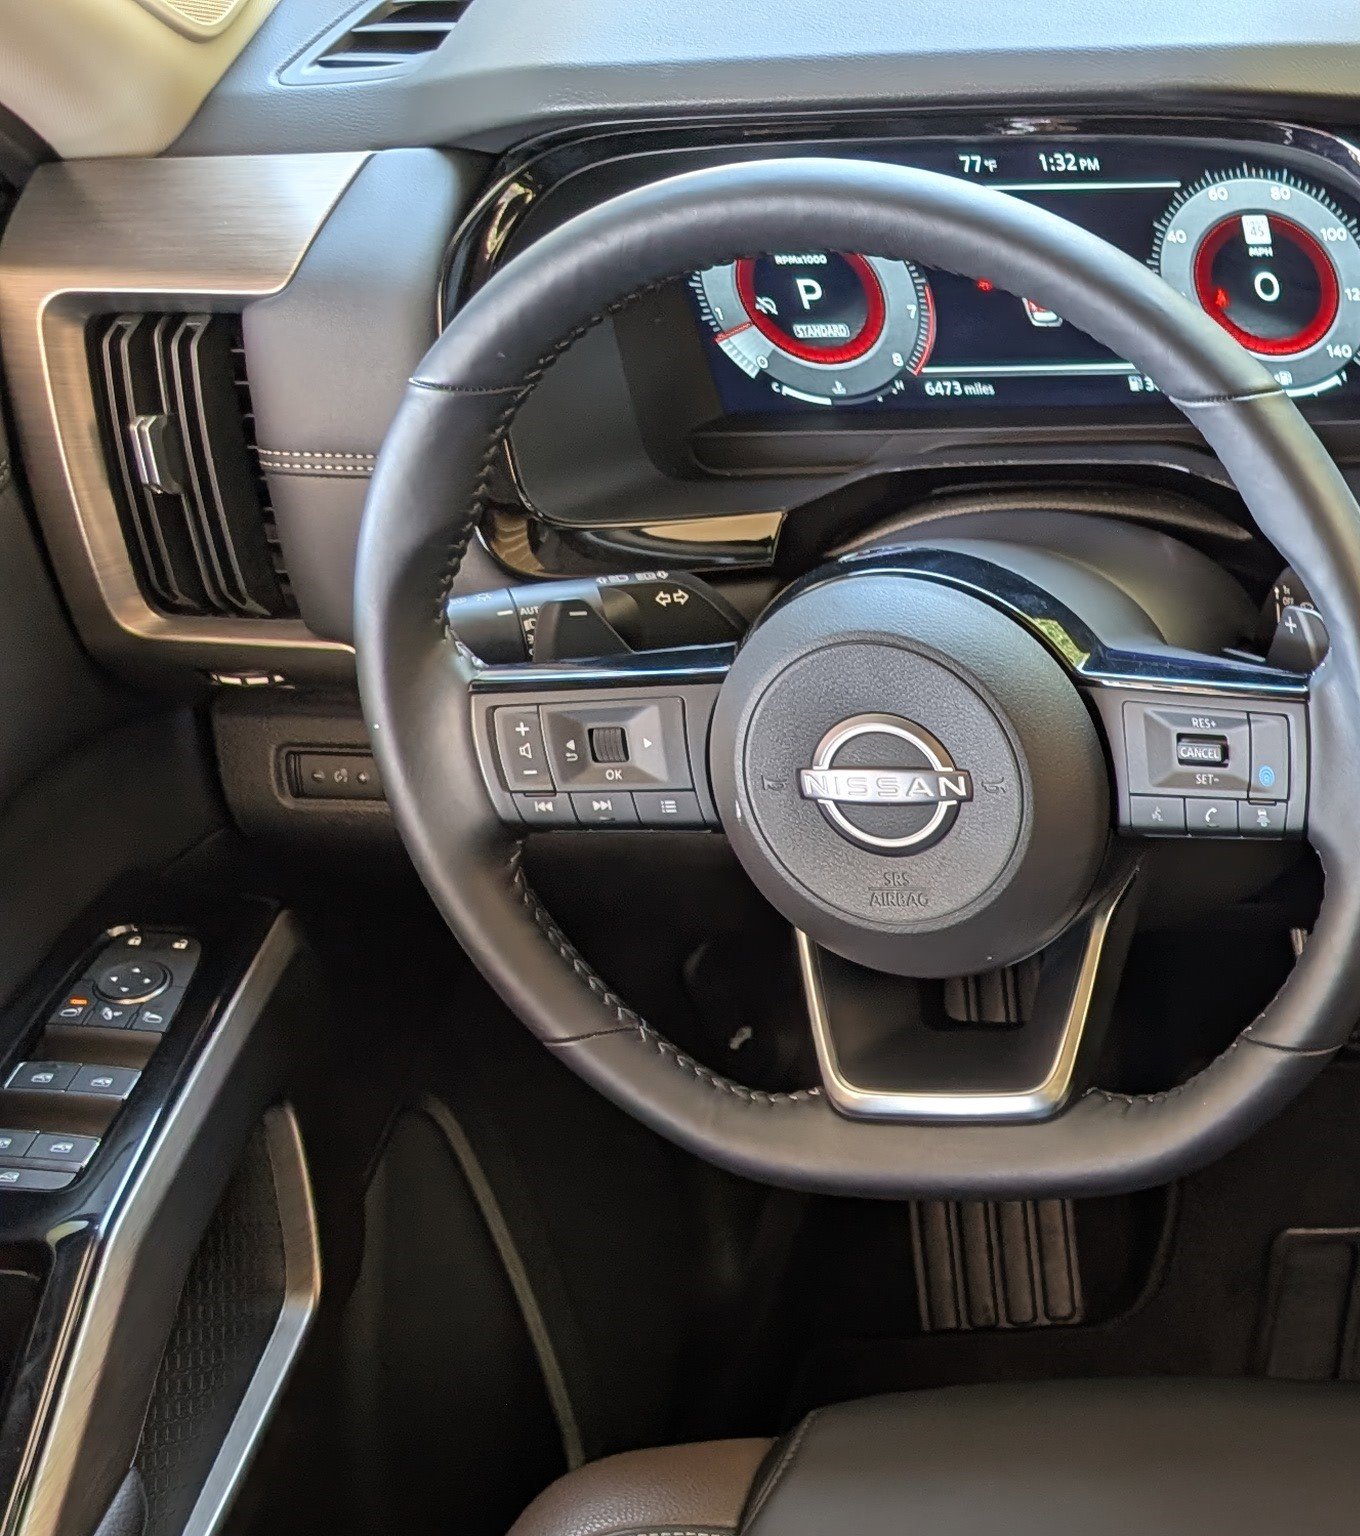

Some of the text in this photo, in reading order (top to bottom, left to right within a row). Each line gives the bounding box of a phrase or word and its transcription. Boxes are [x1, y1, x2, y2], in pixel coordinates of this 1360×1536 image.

[959, 154, 982, 173] 77
[1039, 153, 1100, 172] 1:32 PM
[1208, 189, 1229, 201] 60
[1271, 188, 1291, 200] 80
[1167, 230, 1187, 244] 40
[1320, 228, 1347, 241] 100
[1248, 246, 1273, 257] MPH
[1254, 271, 1280, 302] 0
[795, 278, 823, 310] P
[906, 305, 916, 319] 7
[796, 325, 849, 337] STANDARD
[1326, 344, 1352, 359] 140
[756, 355, 769, 369] 0
[925, 381, 996, 396] 6473 miles
[1191, 717, 1217, 730] RES+
[1179, 747, 1220, 759] CANCEL
[605, 769, 623, 781] OK
[804, 774, 967, 798] NISSAN
[883, 872, 910, 886] SRS
[869, 891, 929, 907] AIRBAG
